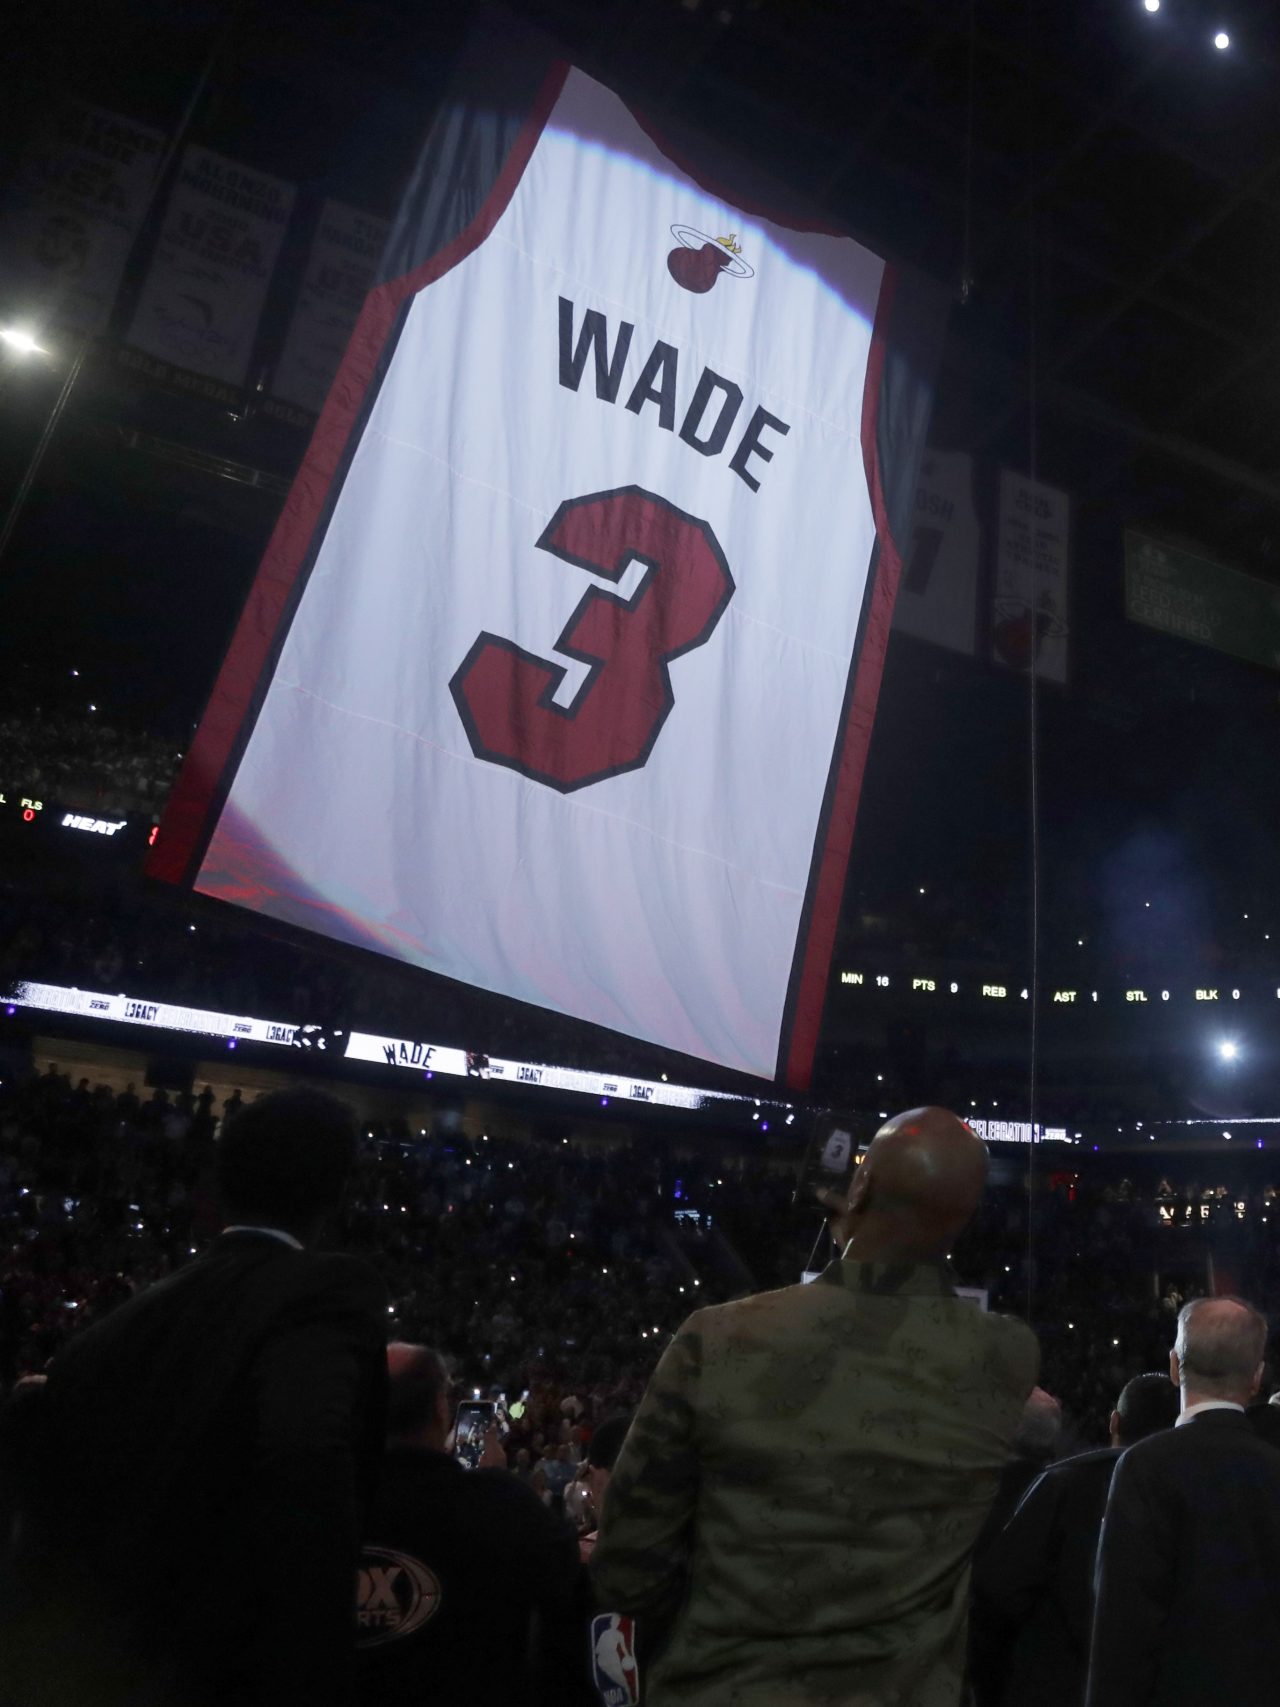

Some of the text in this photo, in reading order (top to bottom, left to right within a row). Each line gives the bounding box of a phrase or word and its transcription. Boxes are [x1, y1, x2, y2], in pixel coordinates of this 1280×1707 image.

[557, 295, 791, 493] WADE
[915, 488, 955, 521] OSH
[448, 484, 737, 795] 3
[21, 798, 43, 811] FLS
[23, 809, 35, 821] 0
[61, 813, 128, 836] HEAT
[841, 972, 863, 985] MIN
[876, 975, 889, 987] 16
[912, 979, 935, 991] PTS
[950, 982, 958, 993] 9
[982, 985, 1006, 998] REB
[1020, 989, 1029, 1000] 4
[1053, 991, 1077, 1002] AST
[1092, 991, 1098, 1002] 1
[1126, 990, 1148, 1001] STL
[1161, 990, 1170, 1001] 0
[1195, 989, 1218, 1001] BLK
[1232, 989, 1240, 1000] 0
[382, 1042, 437, 1069] WADE
